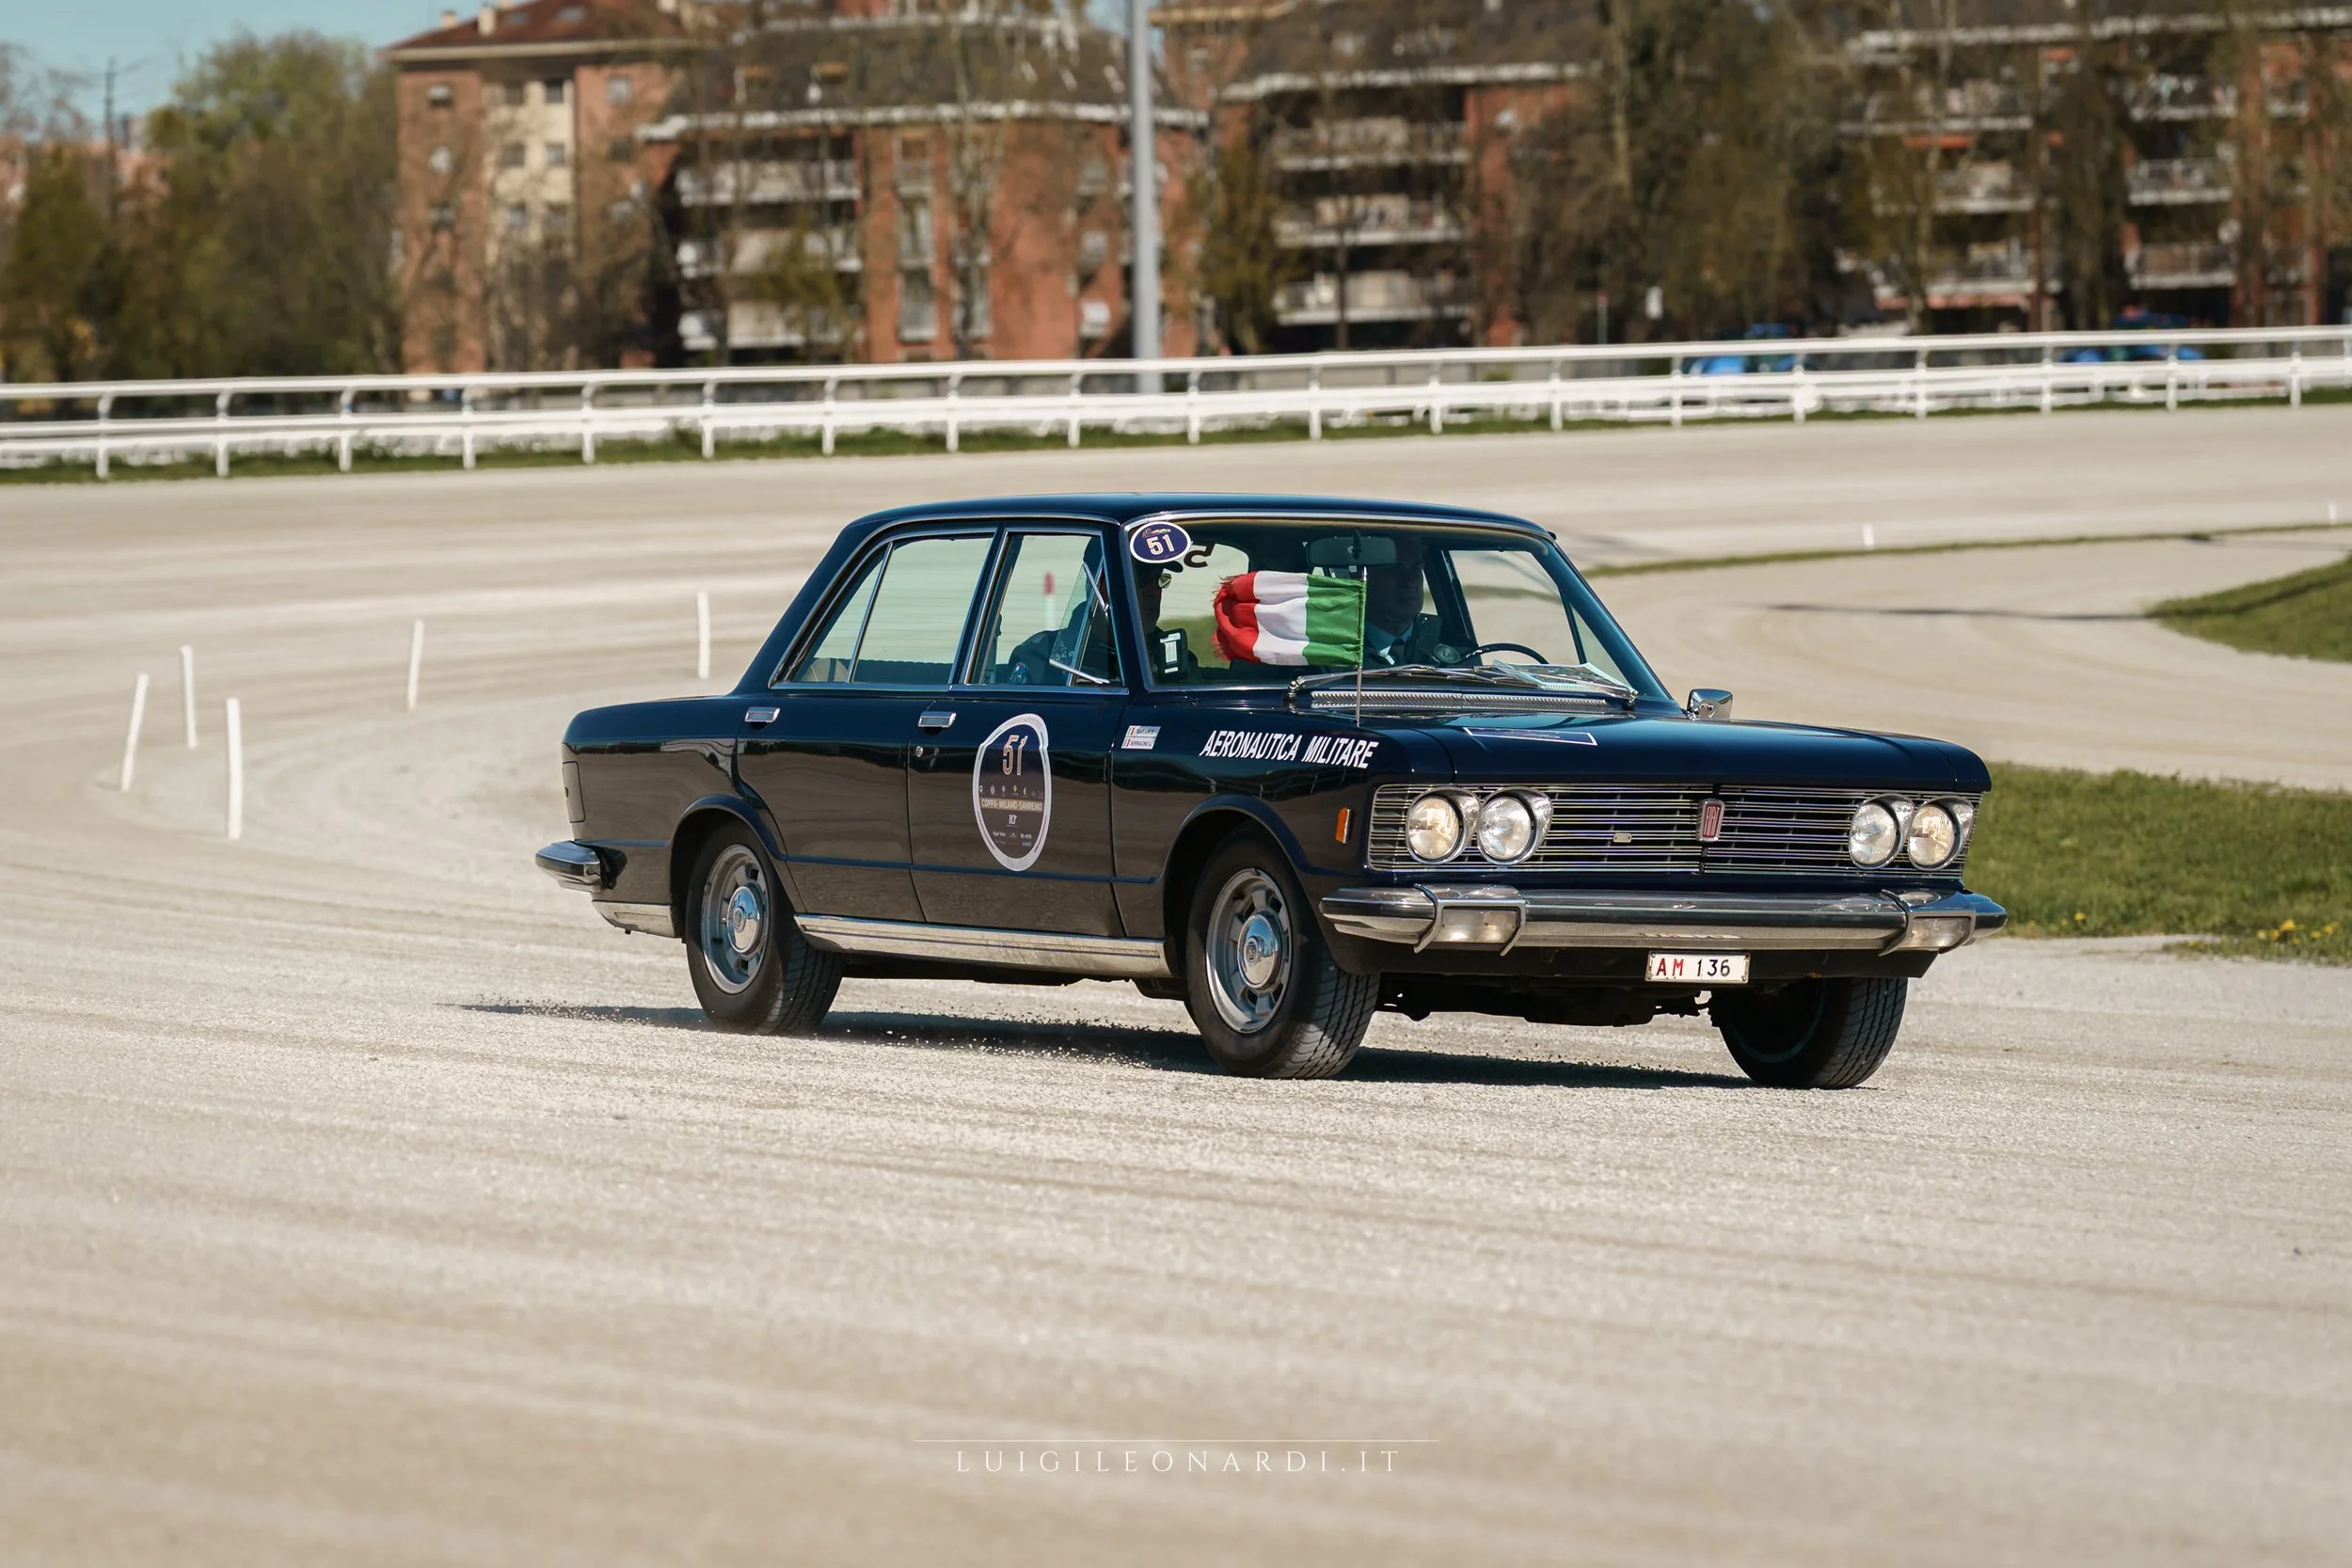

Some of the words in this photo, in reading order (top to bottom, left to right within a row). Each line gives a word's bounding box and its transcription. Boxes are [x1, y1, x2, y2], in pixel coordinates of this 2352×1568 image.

[1146, 533, 1175, 555] 51
[1002, 735, 1028, 775] 51
[1199, 730, 1303, 761] AERONAUTICA
[1301, 736, 1379, 768] MILITARE
[1656, 958, 1684, 976] AM
[1697, 958, 1730, 977] 136
